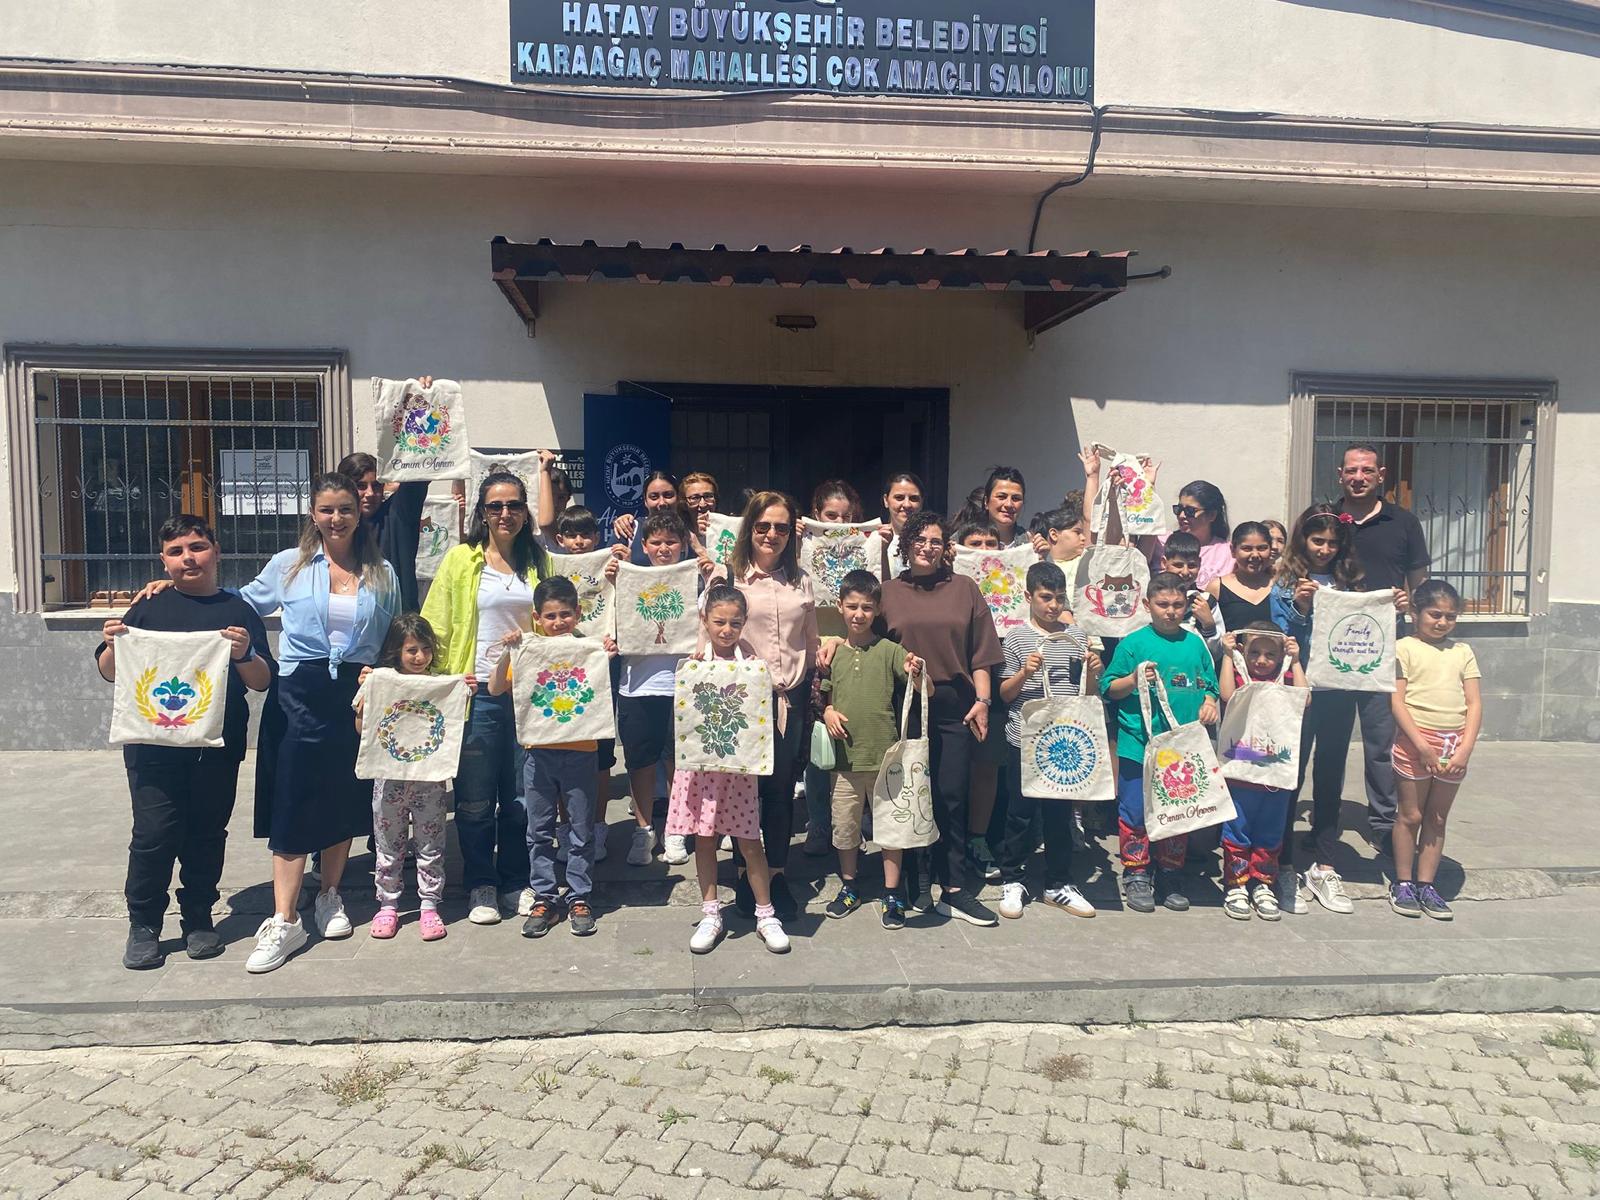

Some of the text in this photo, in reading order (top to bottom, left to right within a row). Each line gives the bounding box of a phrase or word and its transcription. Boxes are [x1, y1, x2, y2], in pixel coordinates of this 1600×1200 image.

[562, 0, 1048, 57] HATAY BÜYÜKŞEHİR BELEDİYESİ
[517, 38, 1089, 97] KARAAĞAÇ MAHALLESİ ÇOK AMAÇLI SALONU
[1344, 620, 1371, 640] Family
